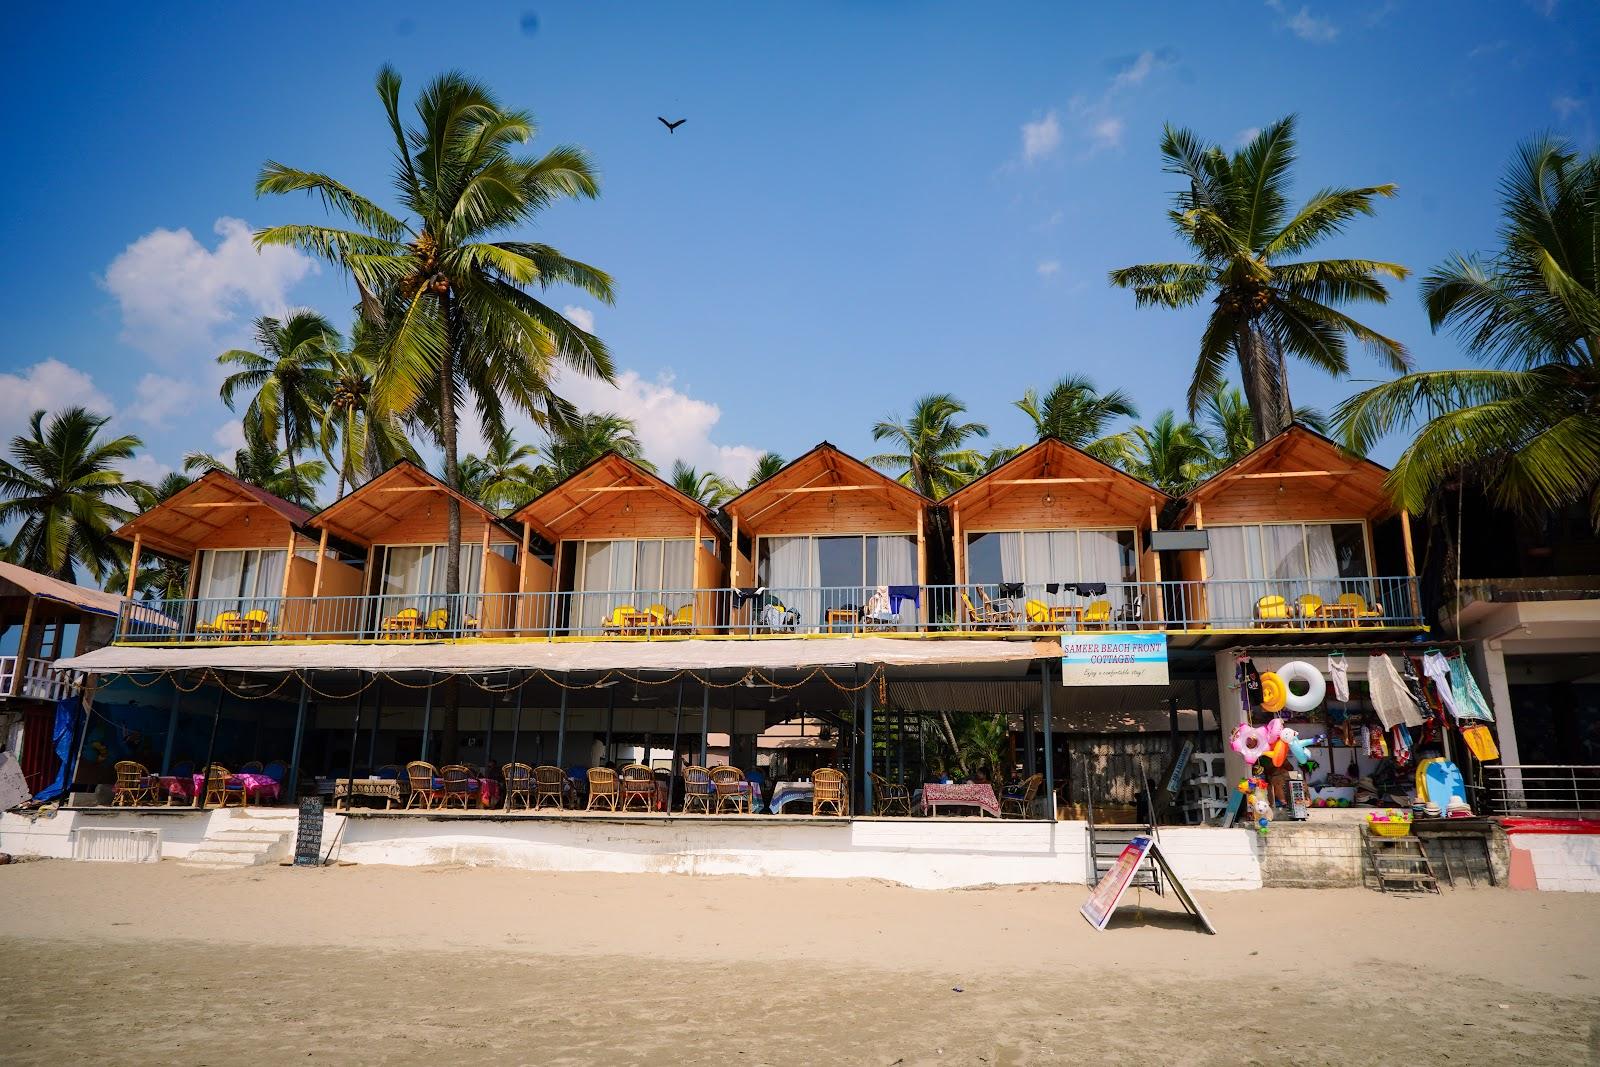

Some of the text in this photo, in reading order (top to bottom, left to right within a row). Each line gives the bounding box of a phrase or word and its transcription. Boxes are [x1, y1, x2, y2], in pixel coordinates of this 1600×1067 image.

[1064, 643, 1162, 653] SAMEER BEACH FRONT
[1090, 654, 1135, 664] COTTAGES
[1083, 669, 1097, 678] Enjoy
[1103, 668, 1129, 677] comfortable
